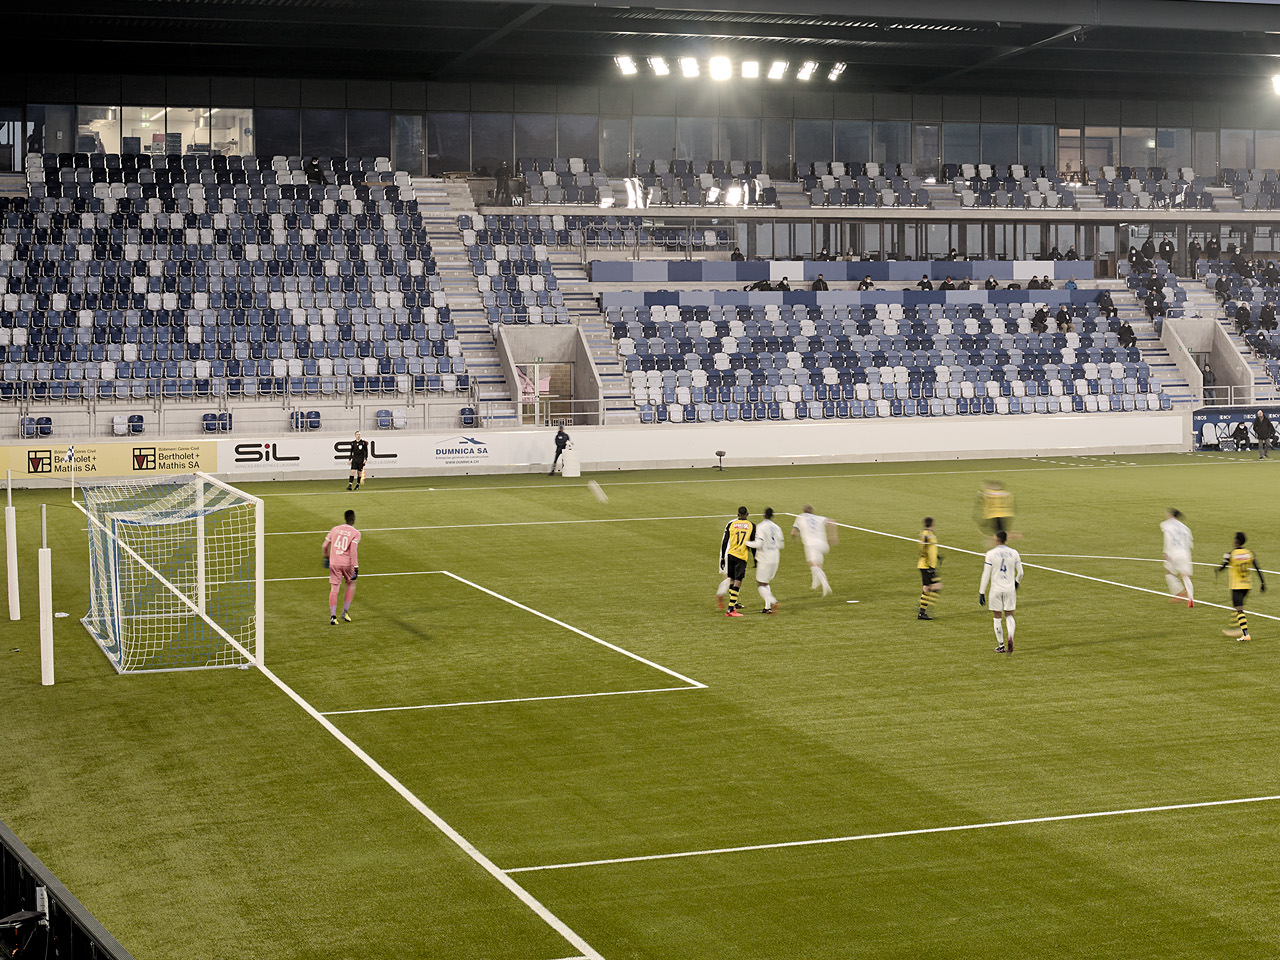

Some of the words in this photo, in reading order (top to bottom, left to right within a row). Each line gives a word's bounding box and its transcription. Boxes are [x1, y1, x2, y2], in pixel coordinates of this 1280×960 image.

[334, 440, 398, 459] SL
[54, 455, 91, 464] Beolet
[158, 453, 194, 461] Bertholet
[158, 461, 186, 469] Mathis
[188, 460, 200, 468] SA
[333, 535, 348, 551] 40
[735, 530, 746, 546] 17
